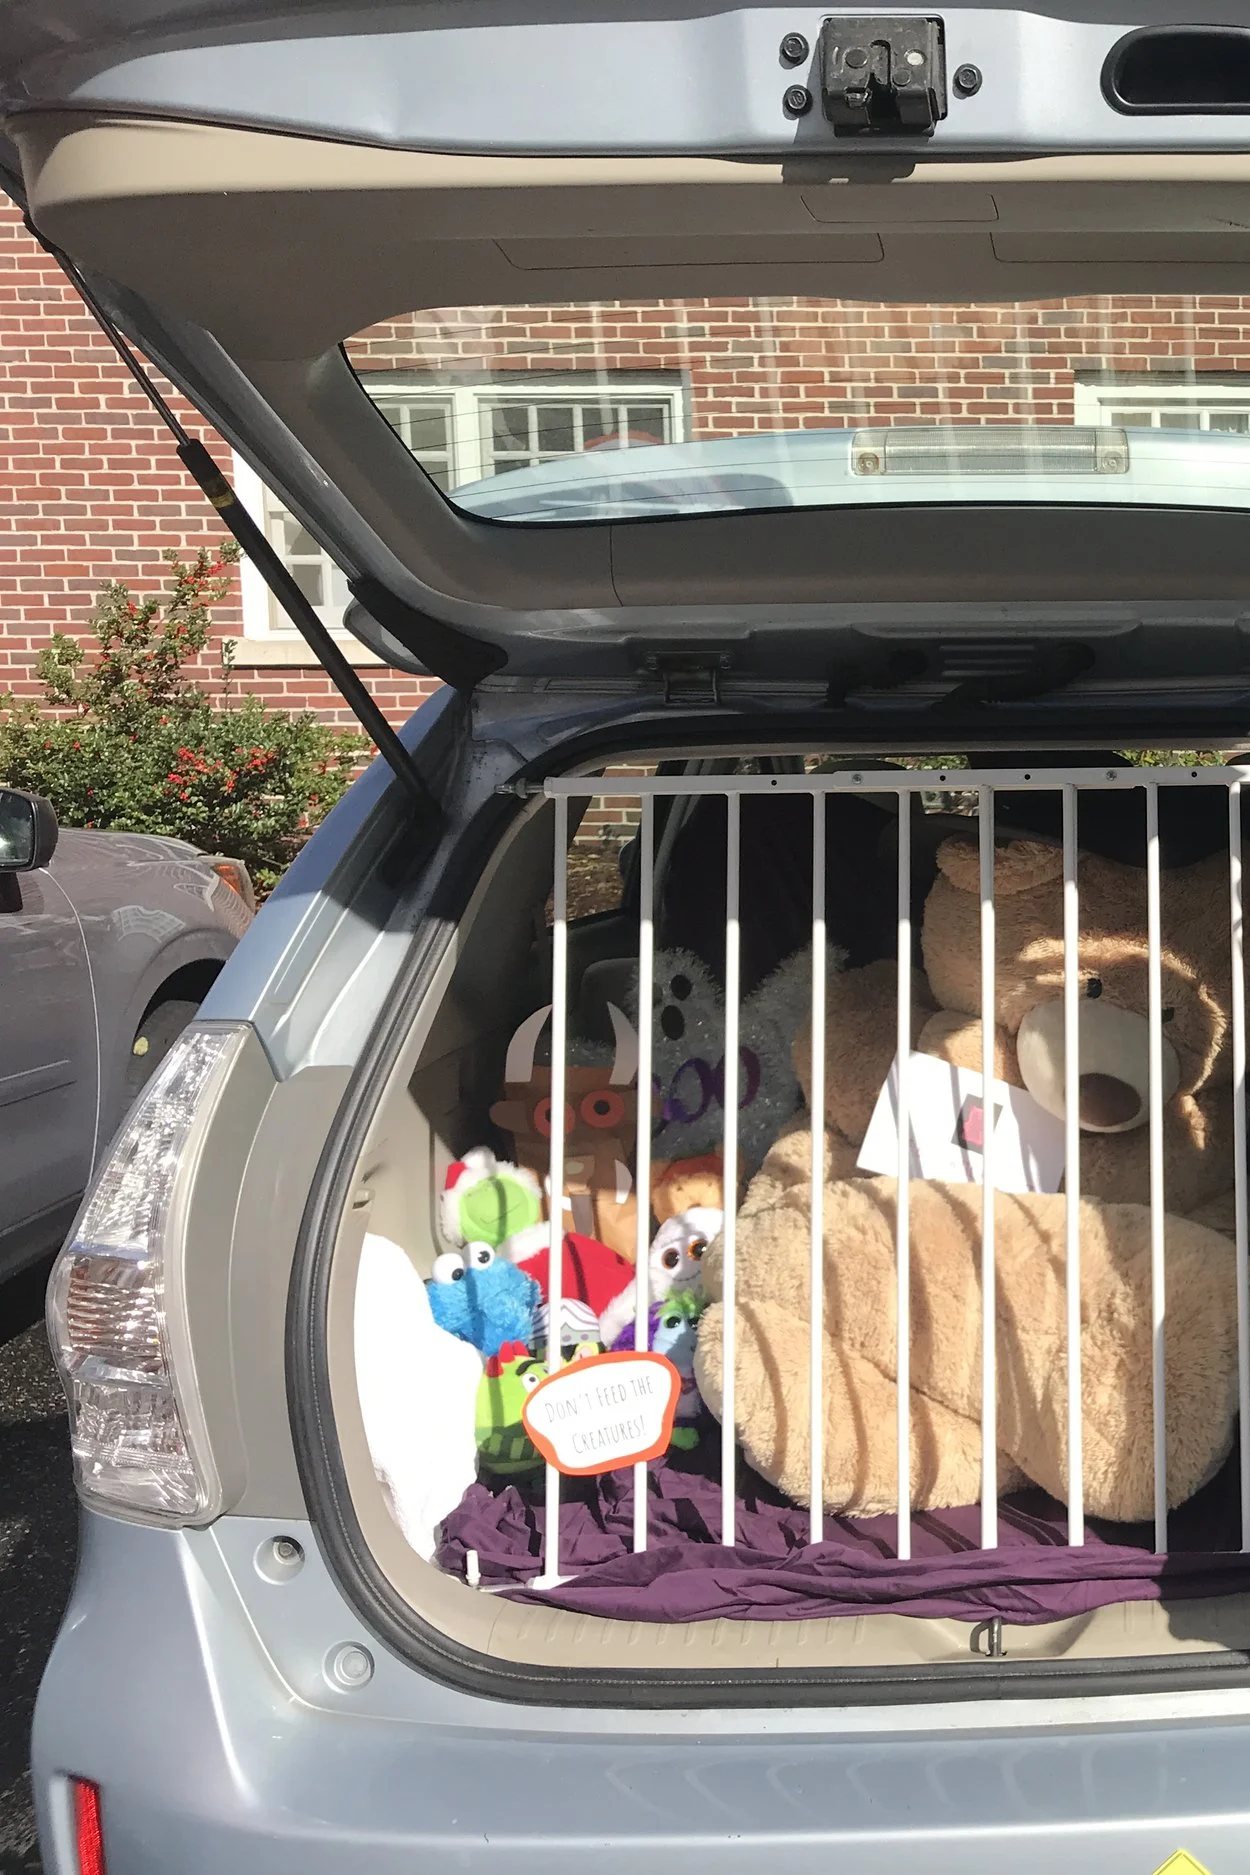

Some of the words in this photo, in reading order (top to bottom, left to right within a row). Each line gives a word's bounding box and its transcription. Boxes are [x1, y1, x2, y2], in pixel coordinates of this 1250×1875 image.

[650, 1046, 761, 1123] OO
[544, 1393, 593, 1423] DON'T
[595, 1383, 627, 1408] FEED
[629, 1375, 653, 1397] THE
[571, 1414, 647, 1454] CREATURES!
